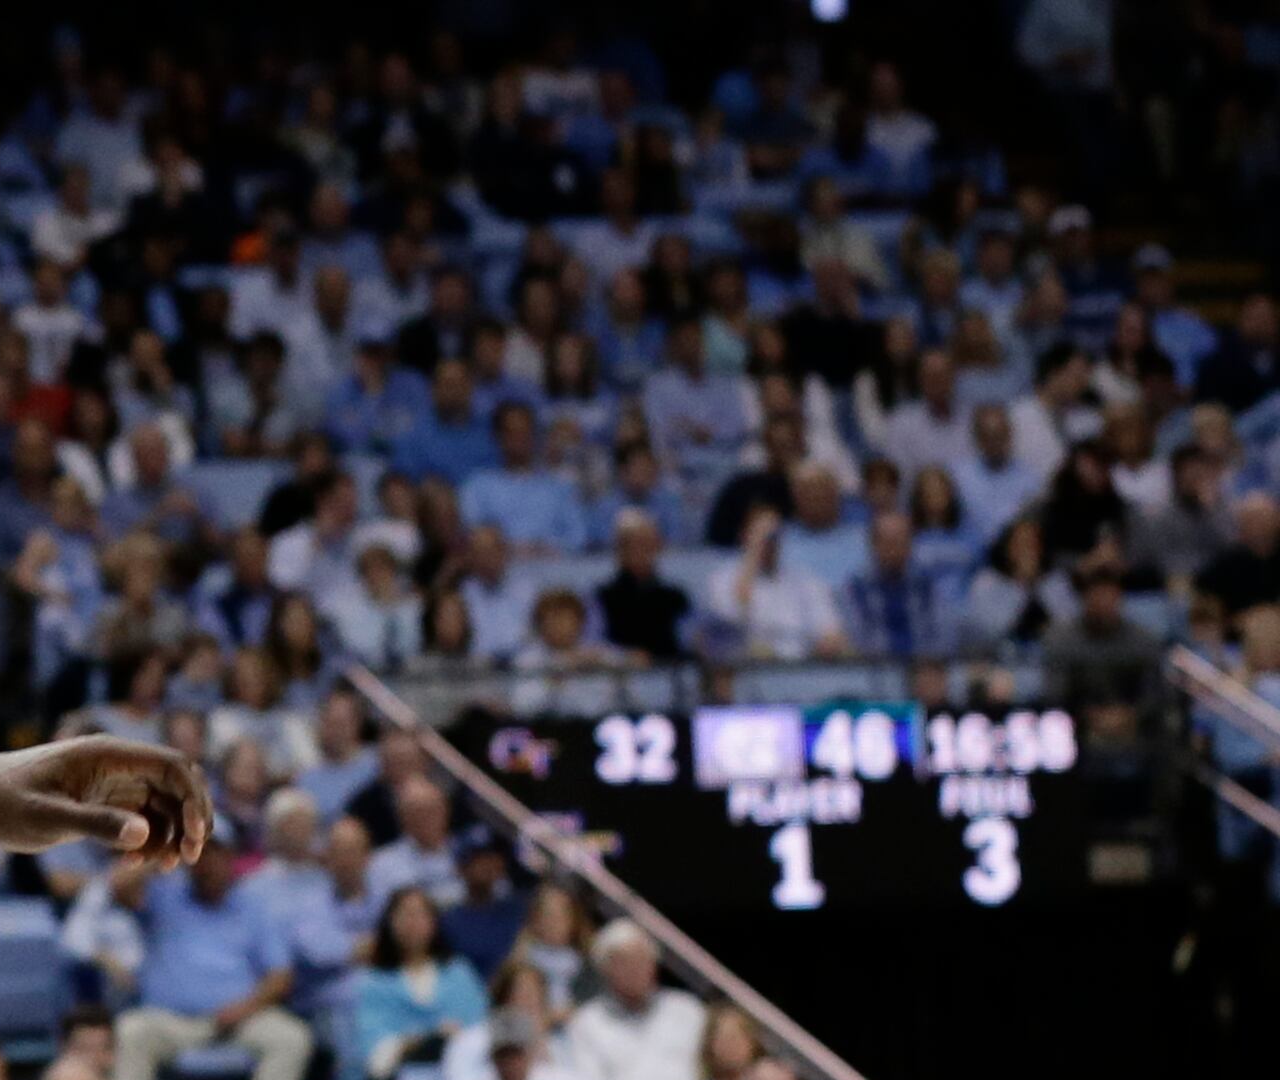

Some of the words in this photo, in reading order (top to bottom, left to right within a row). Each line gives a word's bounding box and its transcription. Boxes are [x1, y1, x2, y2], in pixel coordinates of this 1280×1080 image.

[594, 713, 678, 785] 32
[769, 822, 826, 910] 1
[962, 817, 1022, 906] 3
